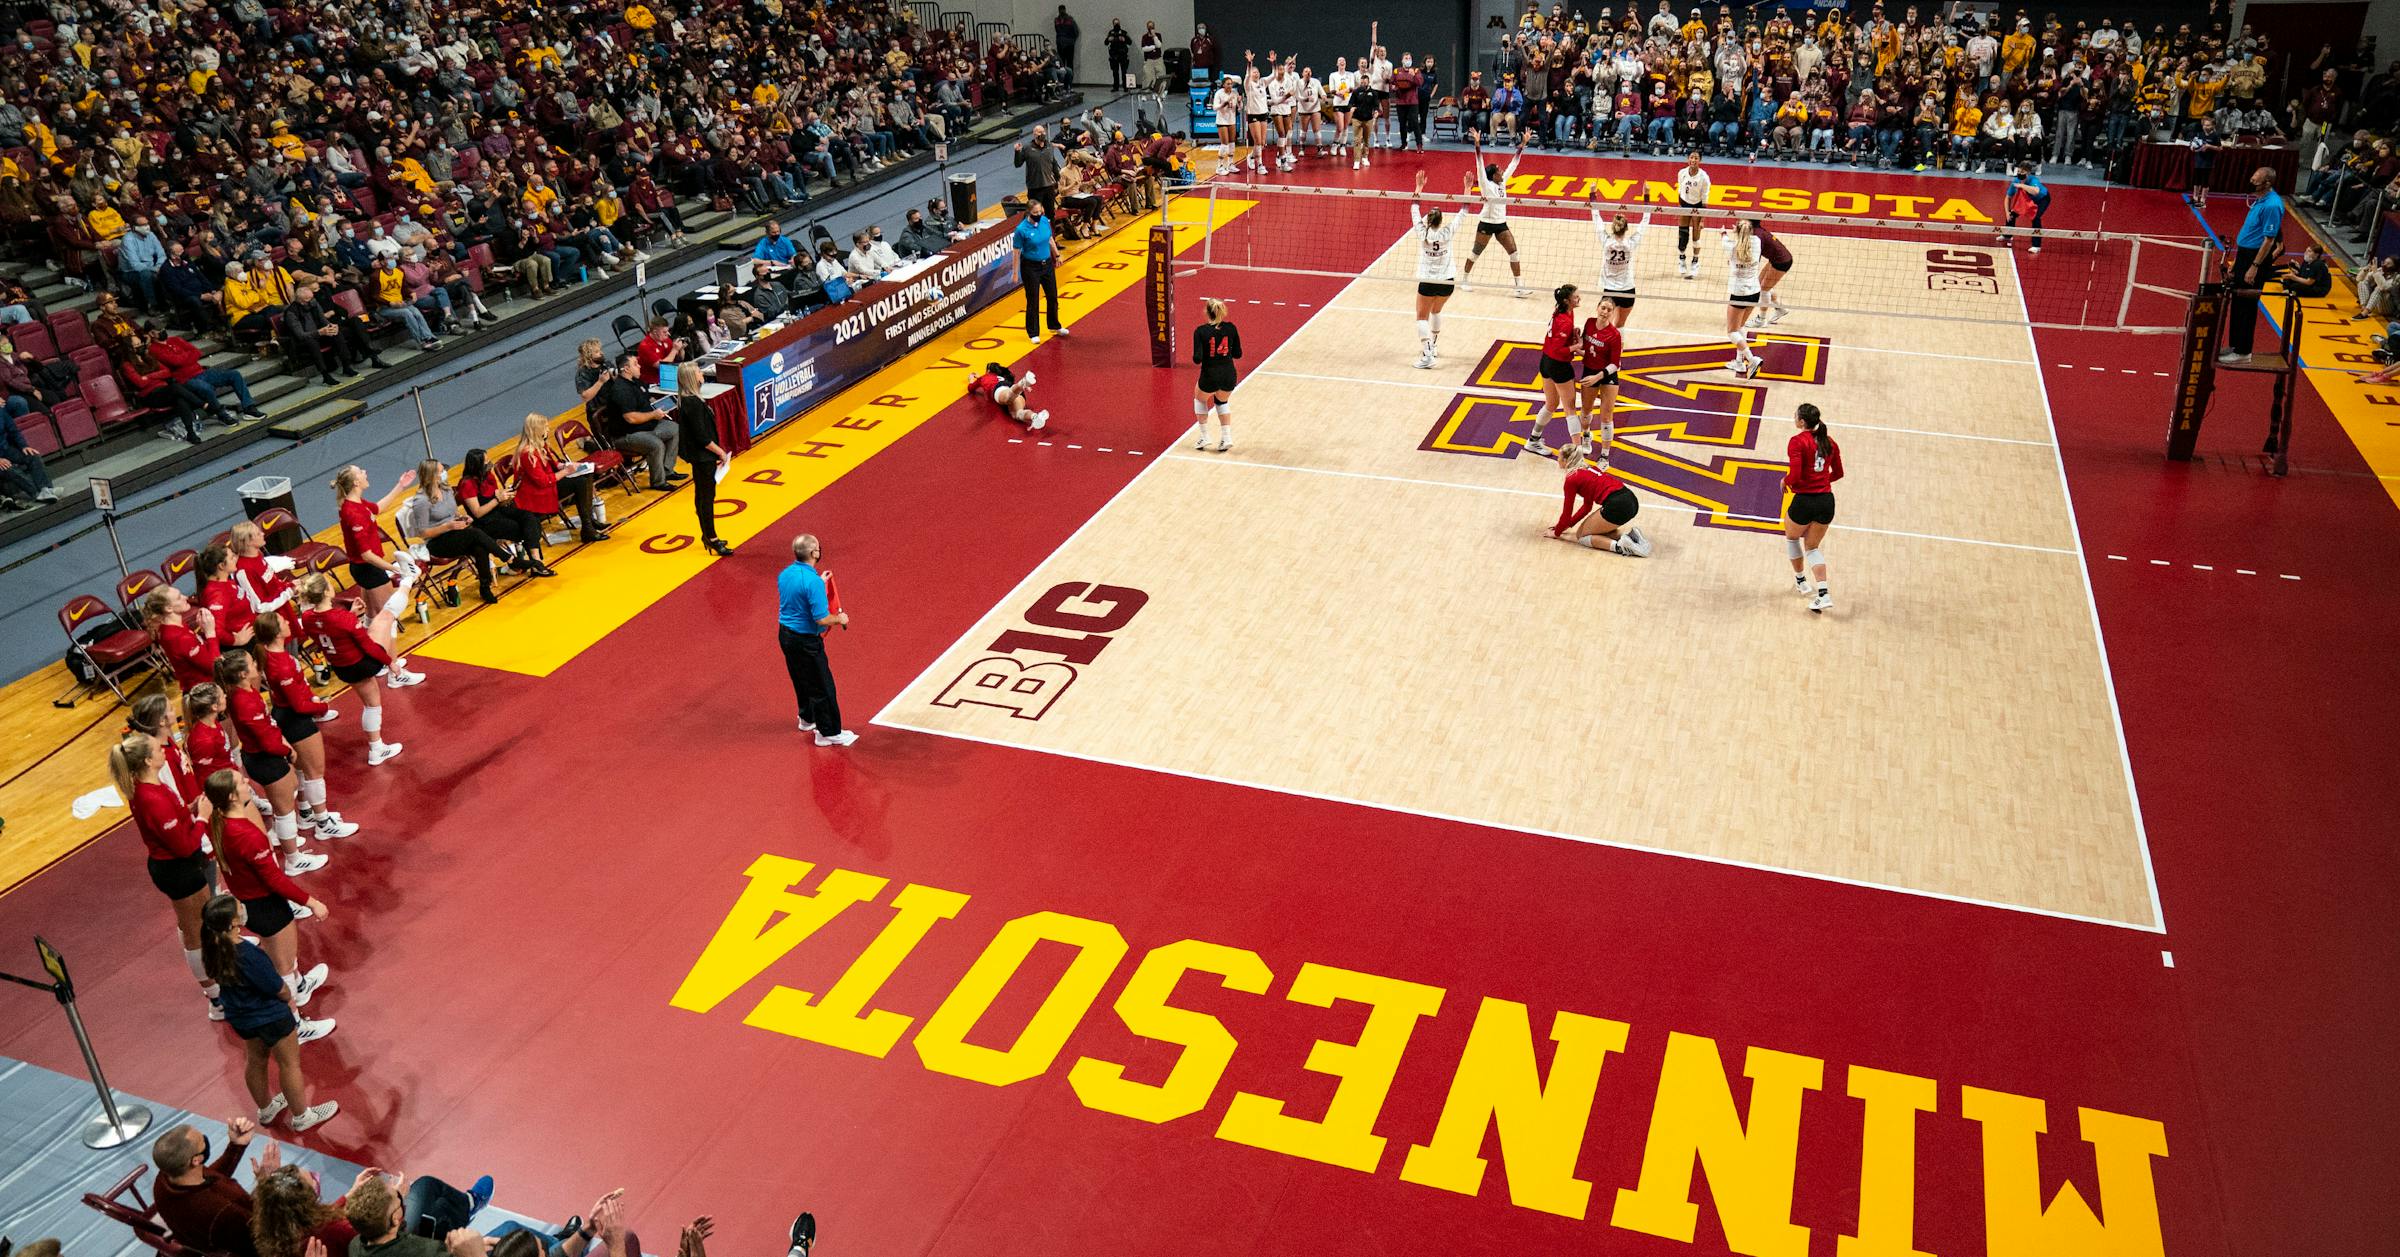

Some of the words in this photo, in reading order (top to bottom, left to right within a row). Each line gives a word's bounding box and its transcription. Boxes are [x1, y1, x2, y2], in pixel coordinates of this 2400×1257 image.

[1487, 16, 1506, 29] M
[1471, 173, 1993, 223] MINNESOTA
[1433, 240, 1440, 251] 5
[1610, 250, 1626, 261] 23
[833, 311, 866, 345] 2021
[867, 272, 942, 327] VOLLEYBALL
[885, 318, 907, 340] FIRST
[907, 314, 923, 330] AND
[922, 298, 950, 321] SECOND
[950, 280, 977, 304] ROUNDS
[1155, 252, 1167, 342] MINNESOTA
[907, 311, 955, 347] MINNEAPOLIS,
[954, 304, 967, 320] MN
[1208, 335, 1230, 358] 14
[774, 363, 816, 396] VOLLEYBALL
[775, 380, 814, 407] CHAMPIONSHIP
[2180, 326, 2209, 431] MINNESOTA
[639, 393, 919, 554] GOPHER
[318, 632, 338, 655] 9
[669, 853, 2169, 1257] MINNESOTA
